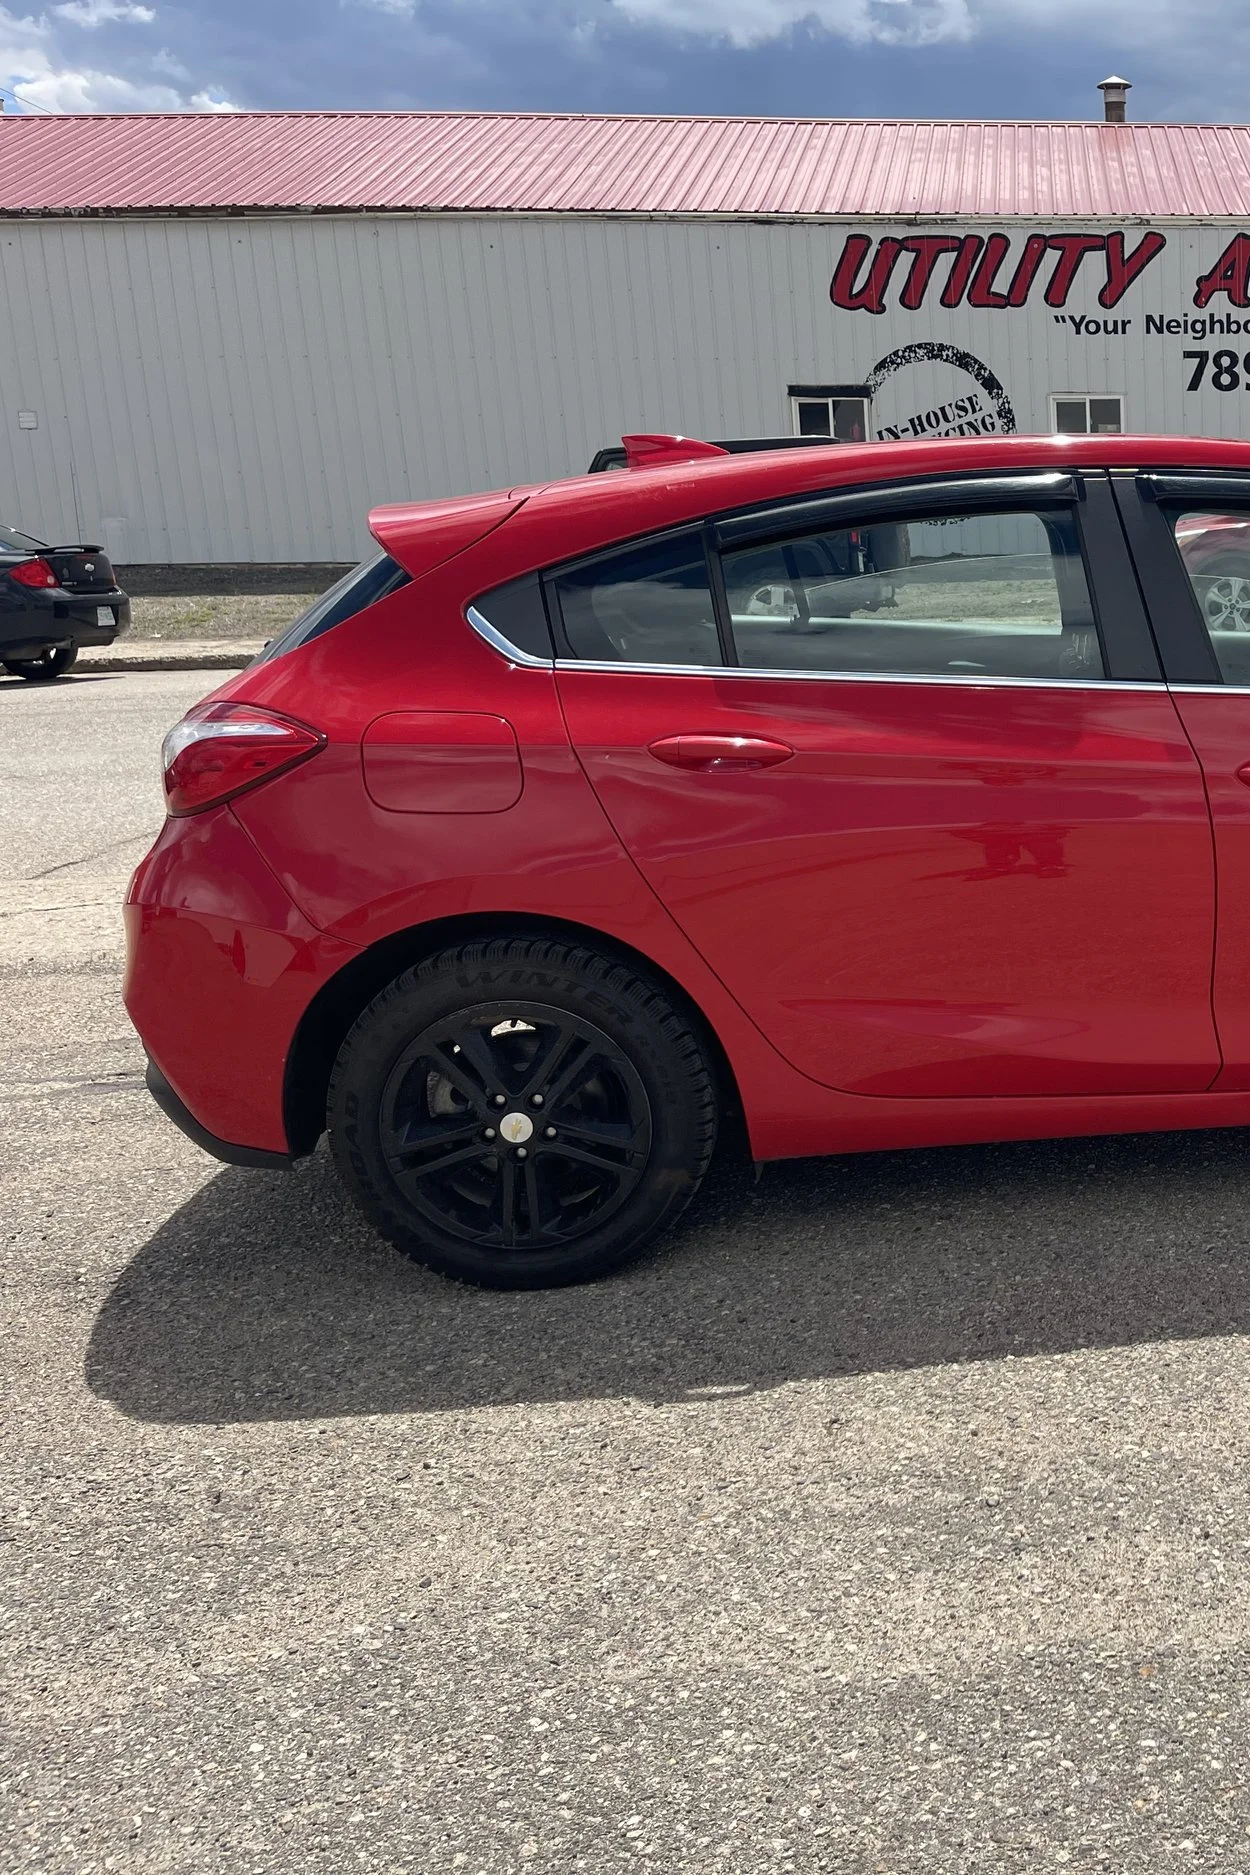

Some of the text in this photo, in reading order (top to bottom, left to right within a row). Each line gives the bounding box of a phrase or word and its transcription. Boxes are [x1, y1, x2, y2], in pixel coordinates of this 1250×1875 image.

[829, 231, 1167, 315] UTILITY
[876, 394, 983, 441] IN-HOUSE
[455, 969, 635, 1025] WINTER
